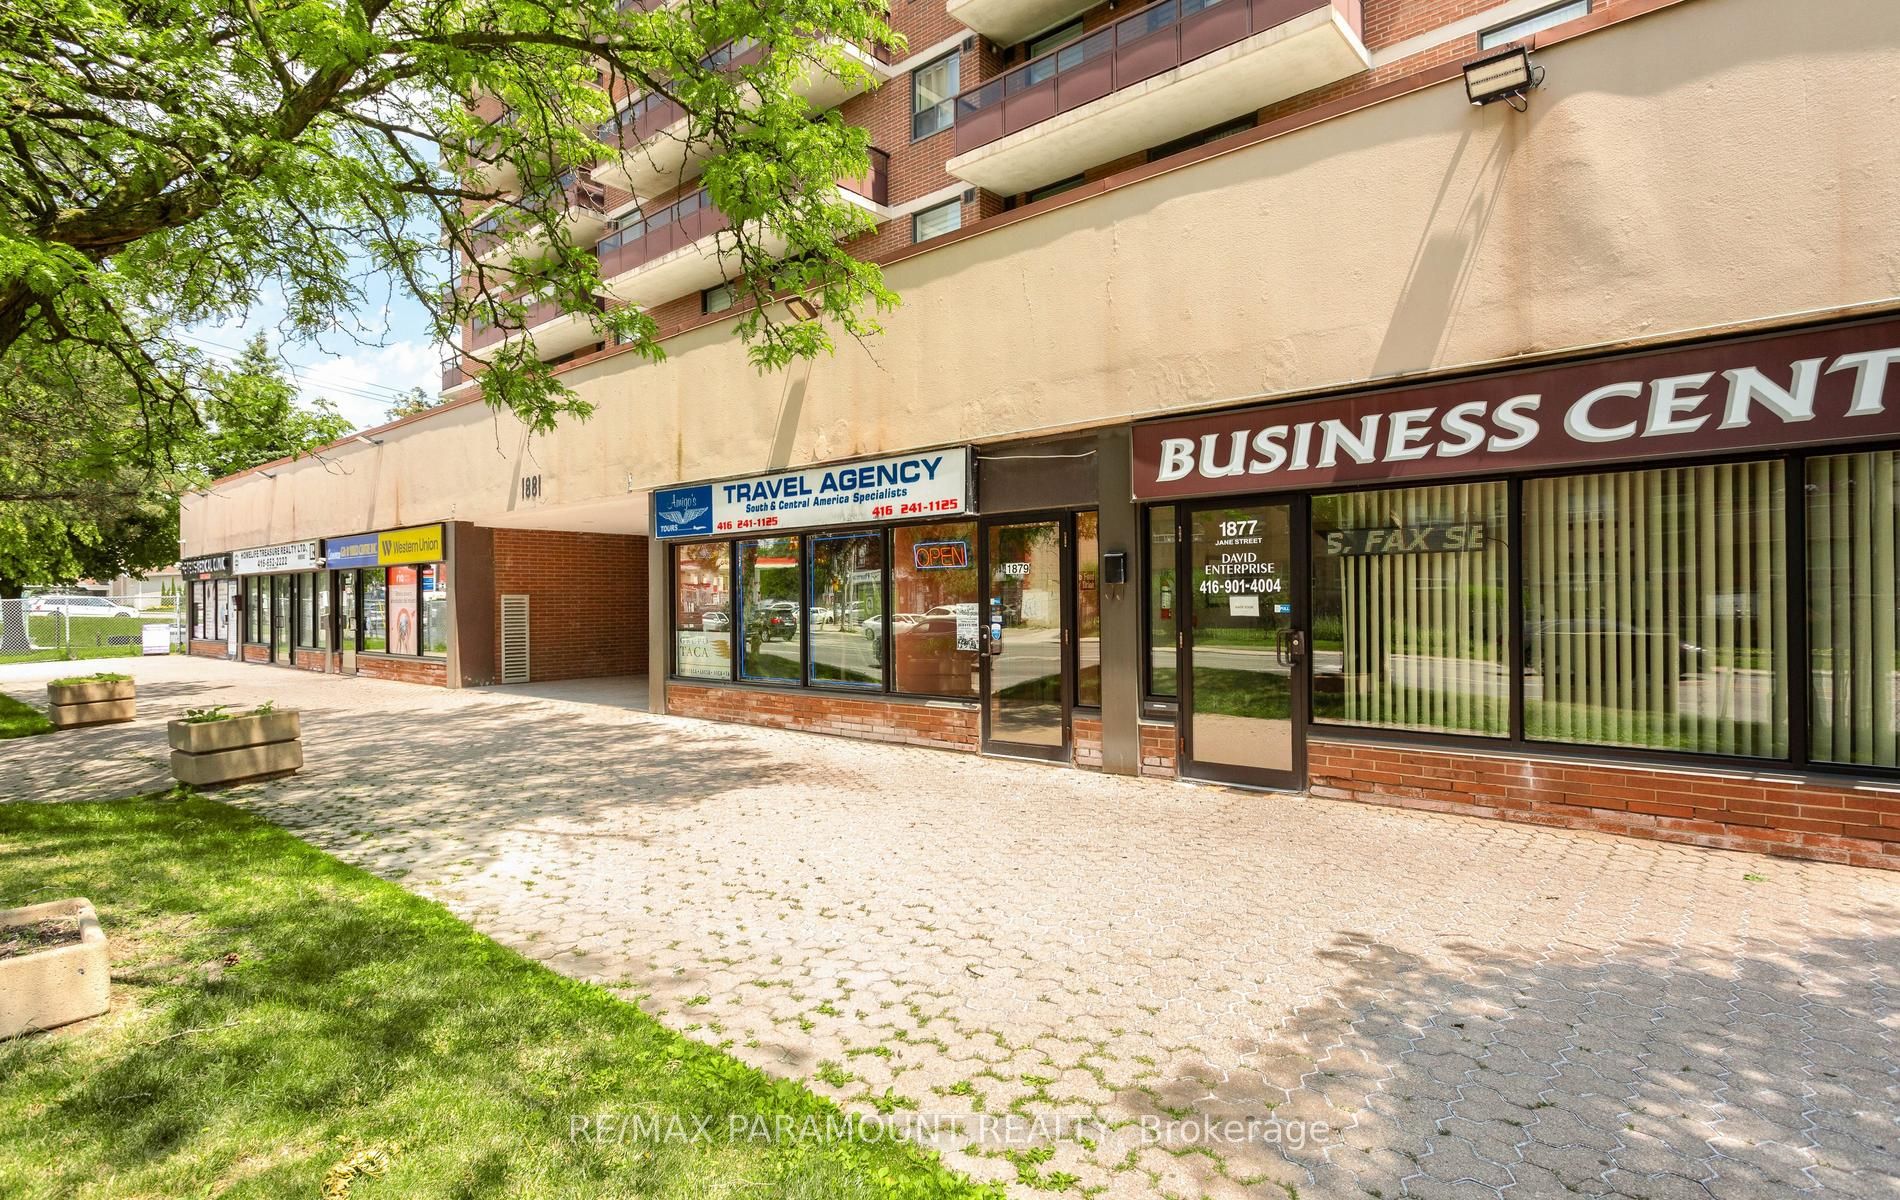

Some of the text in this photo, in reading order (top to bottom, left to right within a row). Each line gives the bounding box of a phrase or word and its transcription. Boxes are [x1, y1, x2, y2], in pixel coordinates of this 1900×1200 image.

[1155, 347, 1900, 483] BUSINESS CENT
[521, 474, 541, 501] 1881
[723, 456, 943, 504] TRAVEL AGENCY
[745, 487, 908, 513] South & Central America Specialists
[871, 498, 958, 517] 416 241-1125
[660, 524, 679, 532] TOURS
[717, 516, 778, 530] 416 241-1125
[1219, 520, 1258, 537] 1877
[393, 540, 419, 554] Western
[418, 537, 439, 552] Union
[1215, 537, 1263, 546] JANE STREET
[1364, 527, 1434, 553] FAX
[240, 549, 259, 559] HOMELIFE
[259, 547, 279, 557] TREASURE
[916, 546, 965, 567] OPEN
[1222, 552, 1257, 564] DAVID
[1007, 564, 1029, 573] 1879
[1205, 563, 1275, 575] ENTERPRISE
[1200, 578, 1281, 594] 416-901-4004
[680, 646, 709, 657] TACA
